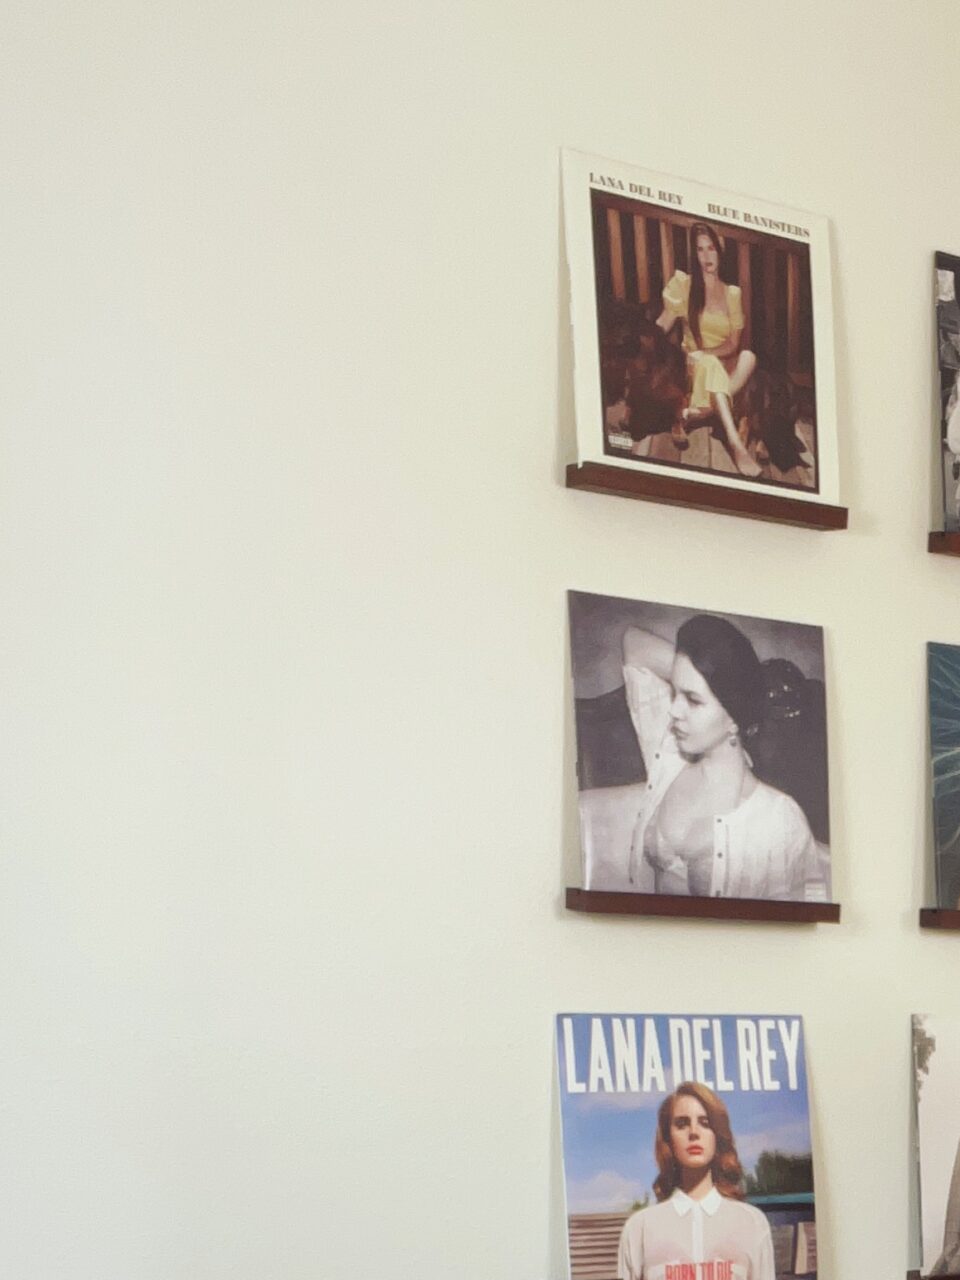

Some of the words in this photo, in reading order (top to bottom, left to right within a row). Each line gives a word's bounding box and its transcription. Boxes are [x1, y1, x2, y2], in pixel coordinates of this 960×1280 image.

[589, 172, 624, 191] LANA
[629, 182, 654, 198] DEL
[658, 190, 683, 205] REY
[707, 203, 740, 220] BLUE
[743, 212, 810, 237] BANISTERS
[562, 1017, 667, 1093] LANA
[668, 1018, 735, 1091] DEL
[736, 1018, 800, 1092] REY
